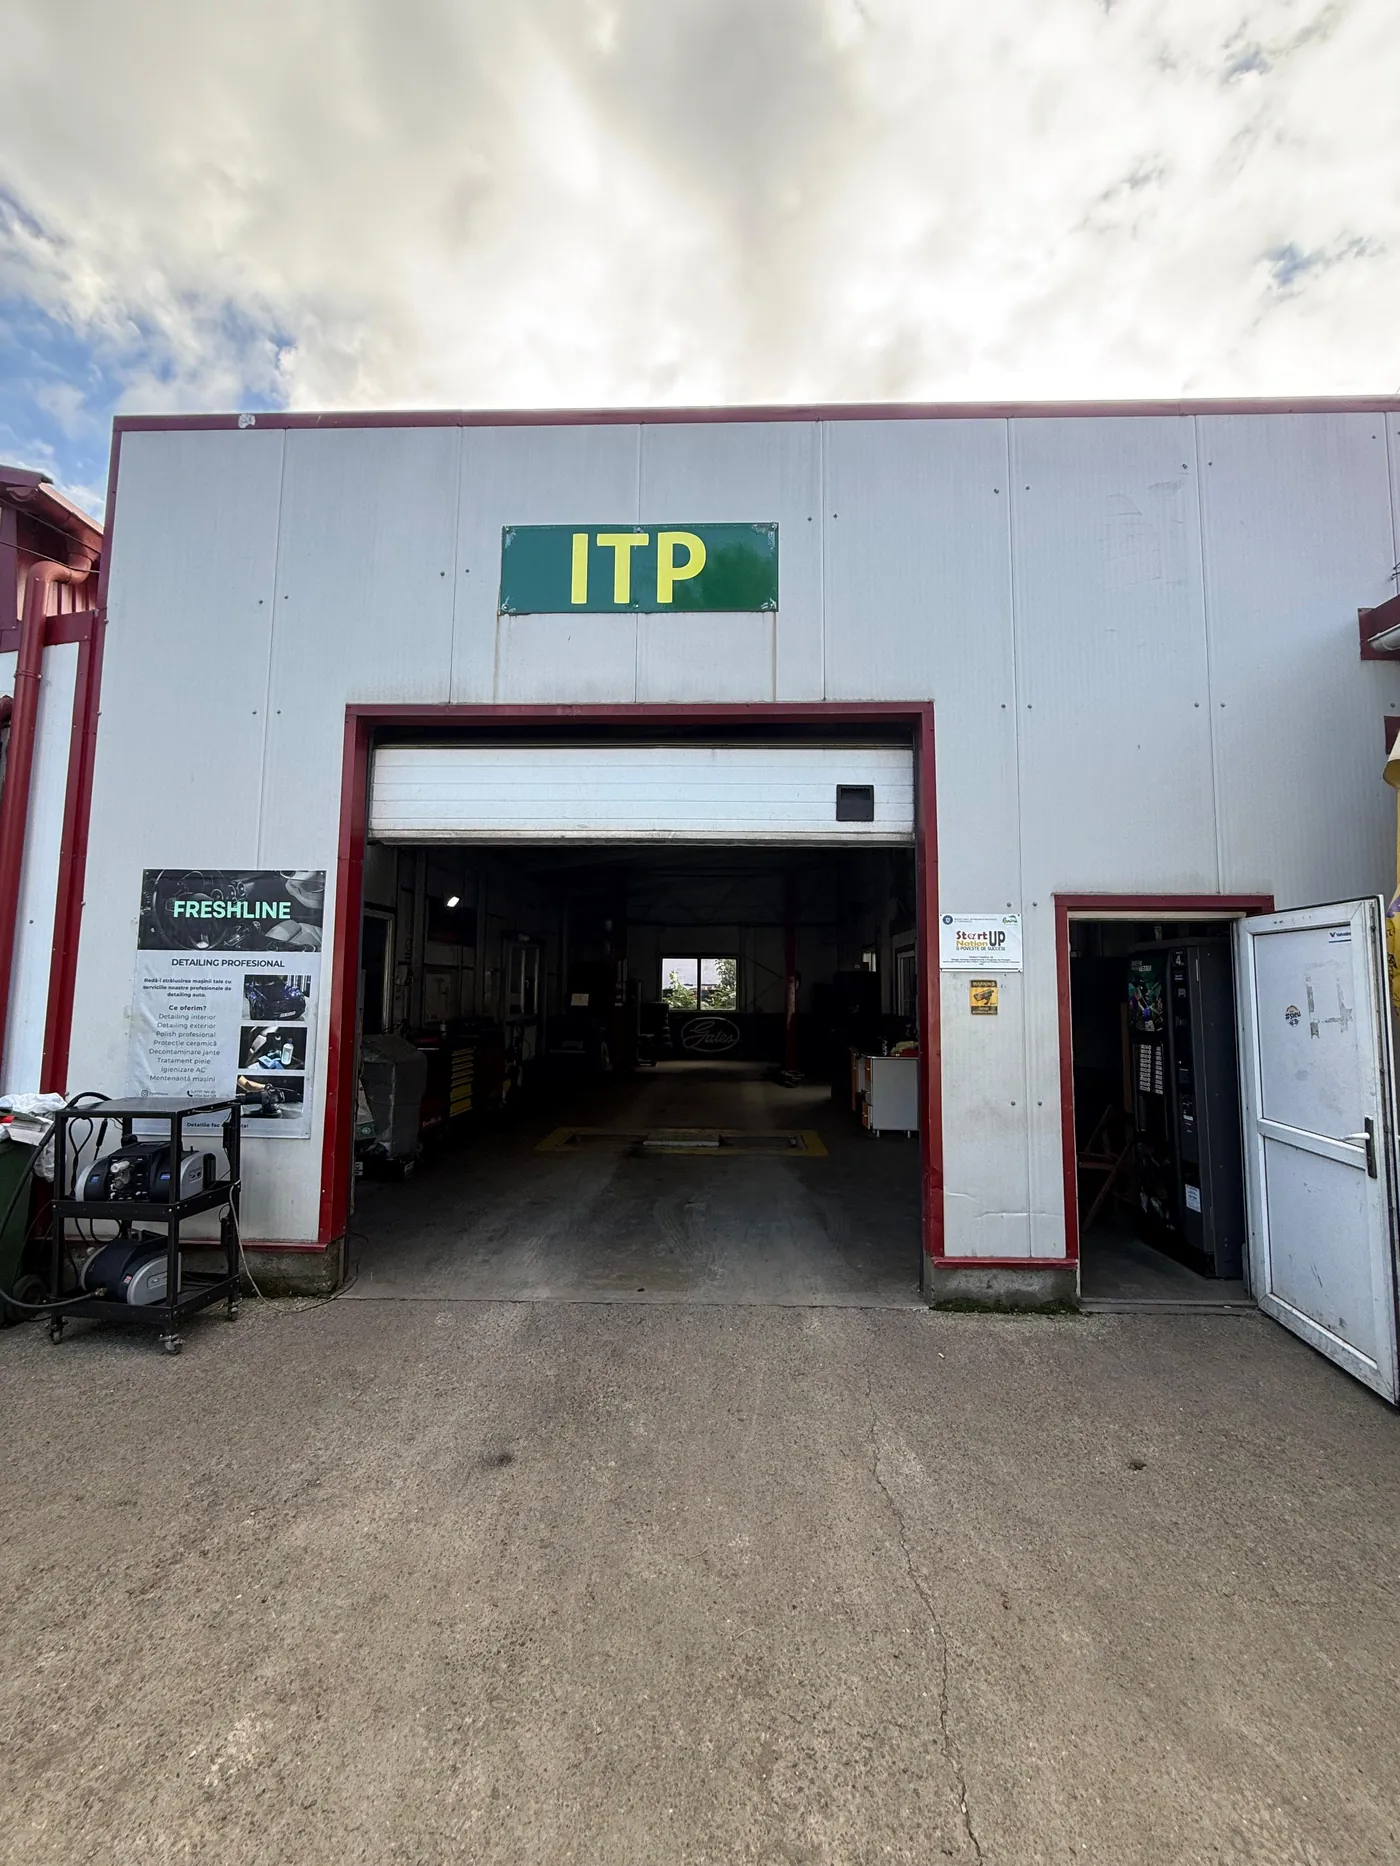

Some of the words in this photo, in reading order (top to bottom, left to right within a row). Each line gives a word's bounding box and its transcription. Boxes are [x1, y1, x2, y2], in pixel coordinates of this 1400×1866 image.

[571, 531, 707, 604] ITP
[173, 900, 291, 919] FRESHLINE
[956, 930, 988, 940] Start
[989, 930, 1006, 947] UP
[171, 958, 220, 967] DETAILING
[221, 959, 285, 968] PROFESIONAL
[158, 1013, 189, 1021] Detailing
[683, 1020, 736, 1048] Gates
